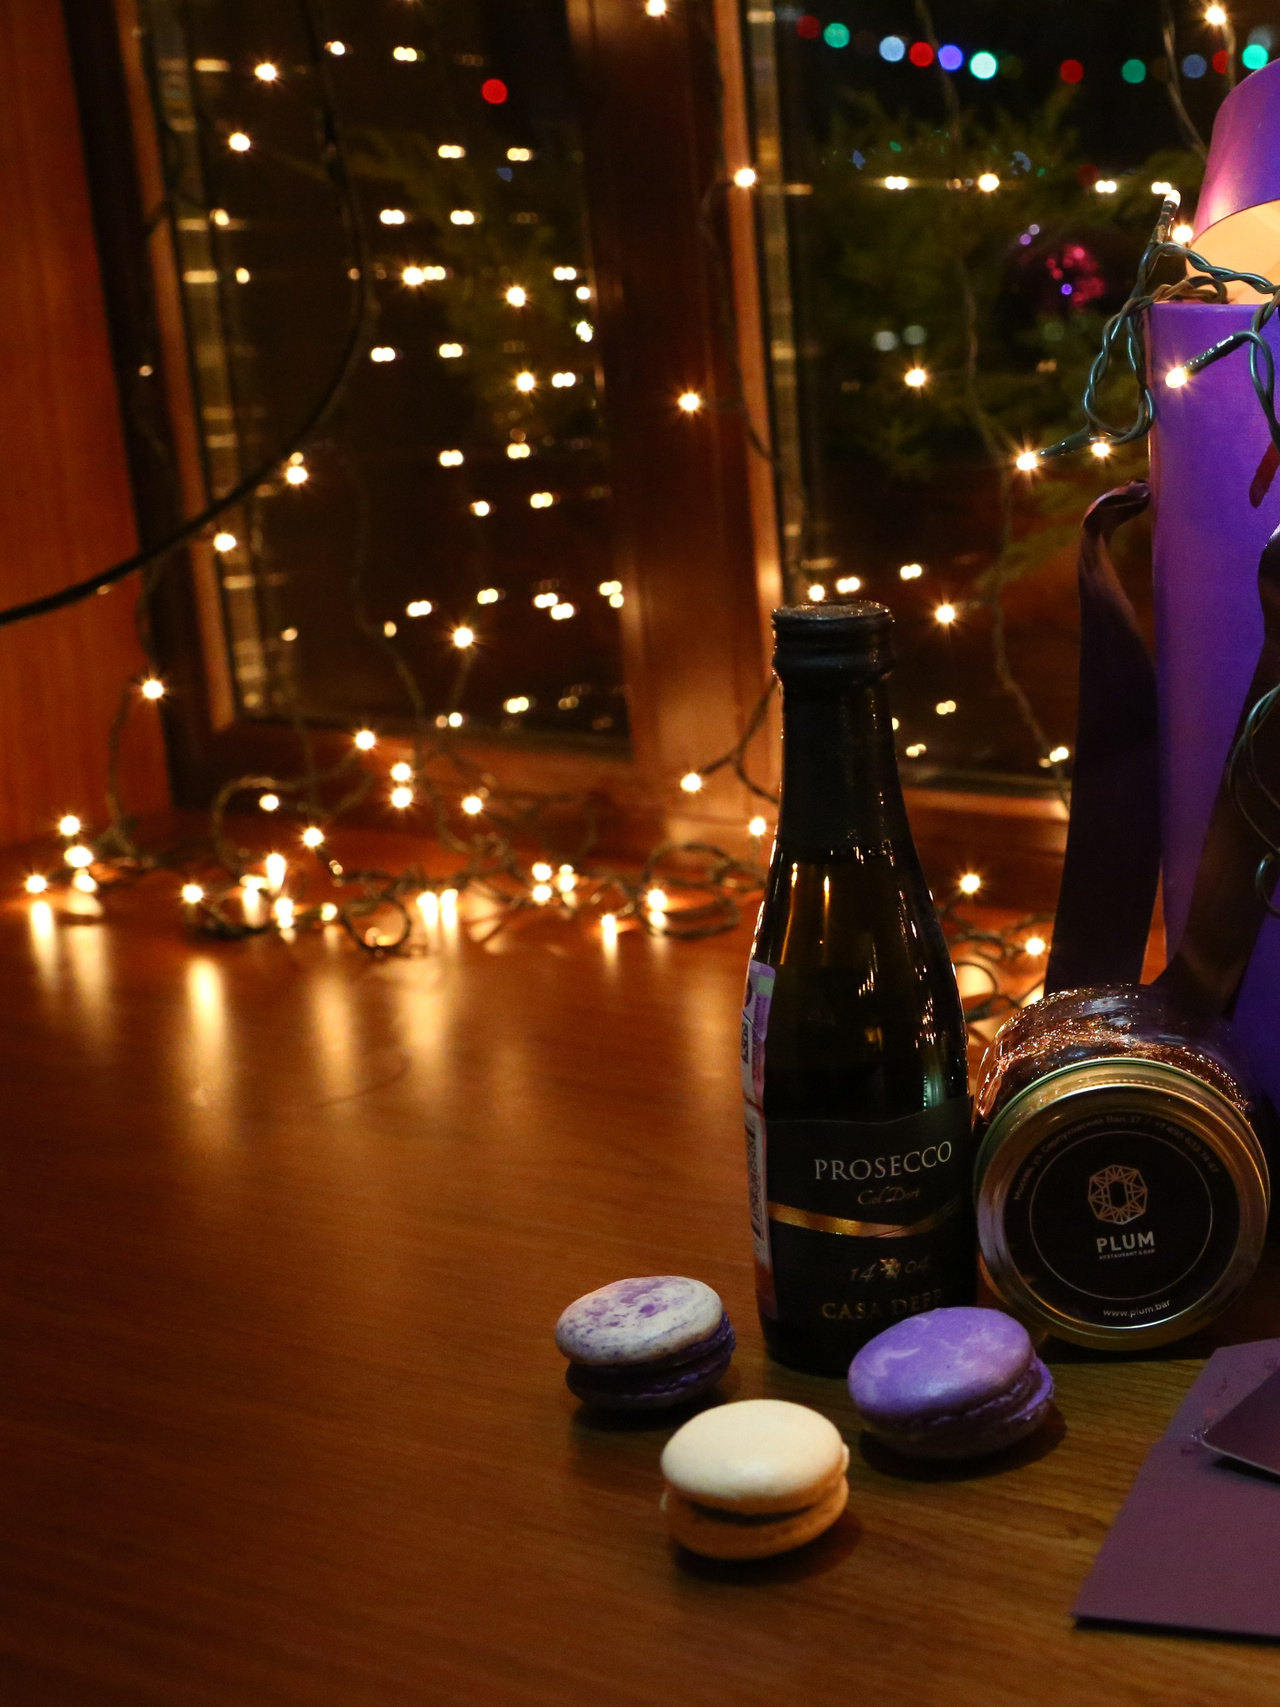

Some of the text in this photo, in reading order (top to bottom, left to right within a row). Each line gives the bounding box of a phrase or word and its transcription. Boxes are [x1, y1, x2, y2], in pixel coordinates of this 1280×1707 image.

[813, 1140, 953, 1181] PROSECCO
[1096, 1230, 1155, 1253] PLUM
[821, 1303, 884, 1320] CASA
[1103, 1300, 1171, 1319] www.plum.bar
